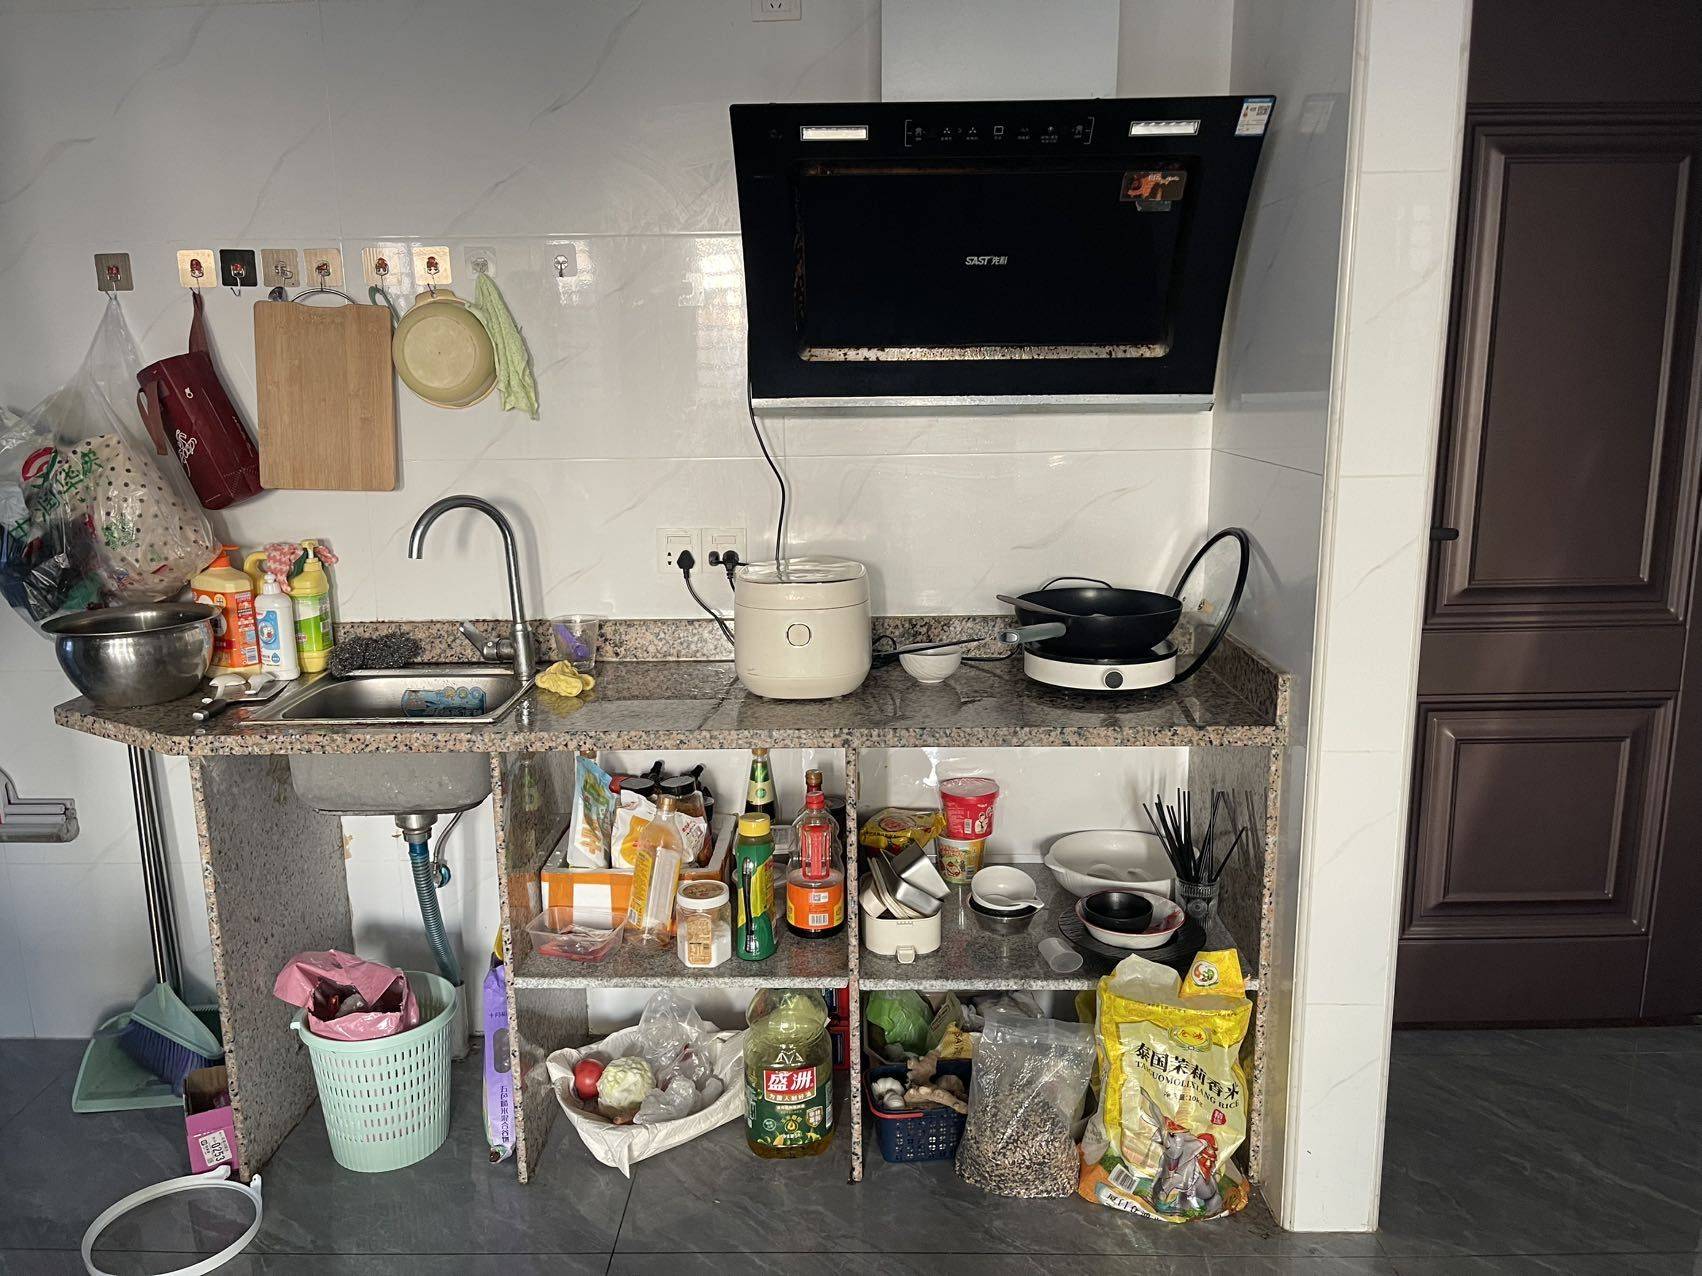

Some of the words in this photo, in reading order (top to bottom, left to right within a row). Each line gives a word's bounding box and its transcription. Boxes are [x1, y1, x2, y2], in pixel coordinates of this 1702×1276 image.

[965, 256, 990, 265] SAST
[768, 1071, 812, 1091] 盛洲
[1135, 1042, 1239, 1100] 泰国茉莉香米
[1218, 1100, 1240, 1109] RICE
[211, 1142, 226, 1162] 0253
